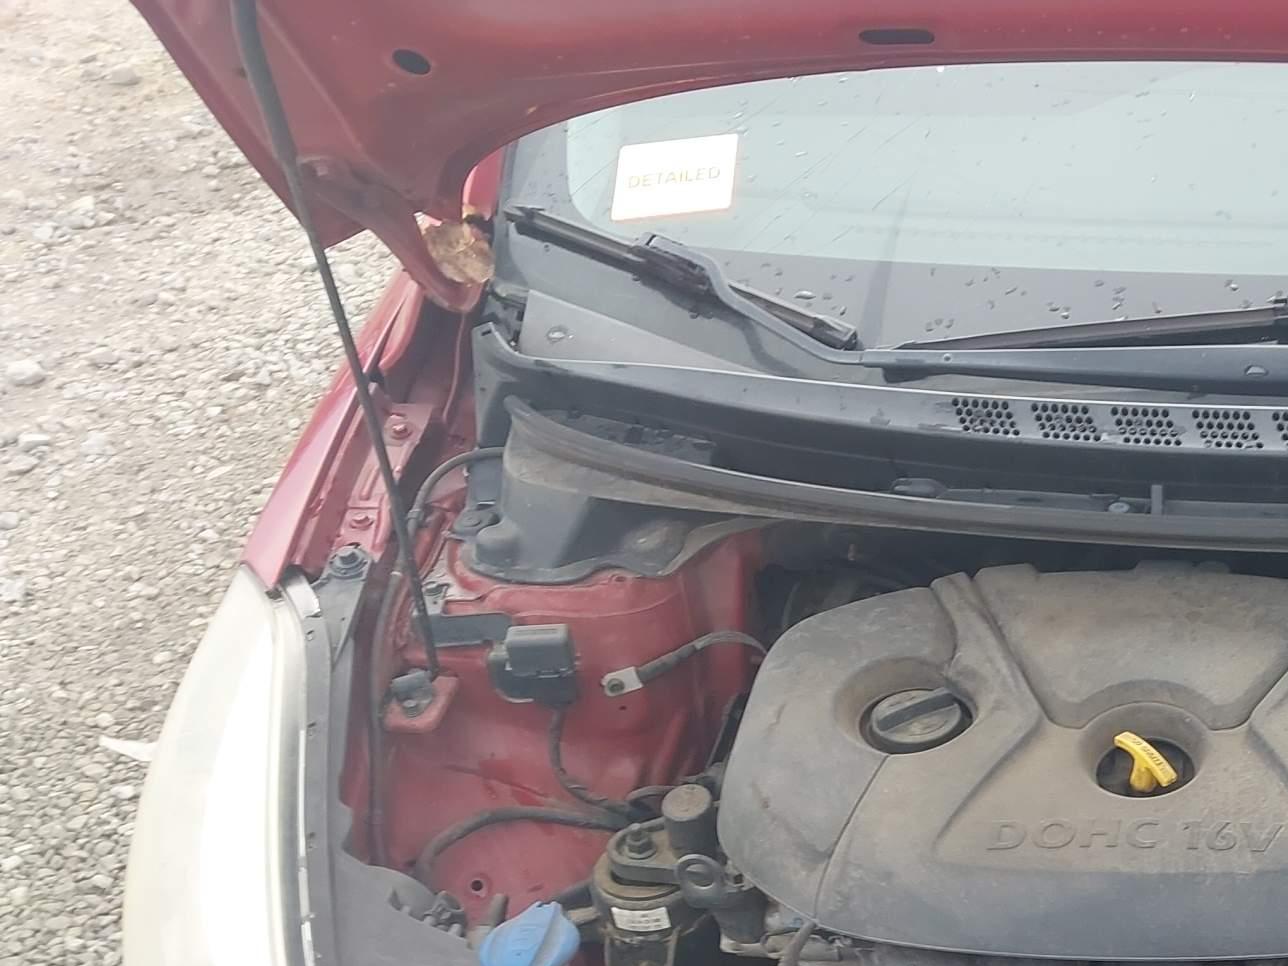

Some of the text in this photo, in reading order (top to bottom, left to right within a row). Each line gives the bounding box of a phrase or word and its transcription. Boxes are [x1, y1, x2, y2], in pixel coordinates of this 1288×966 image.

[627, 166, 721, 189] DETAILED
[986, 819, 1286, 853] DOHC 16V
